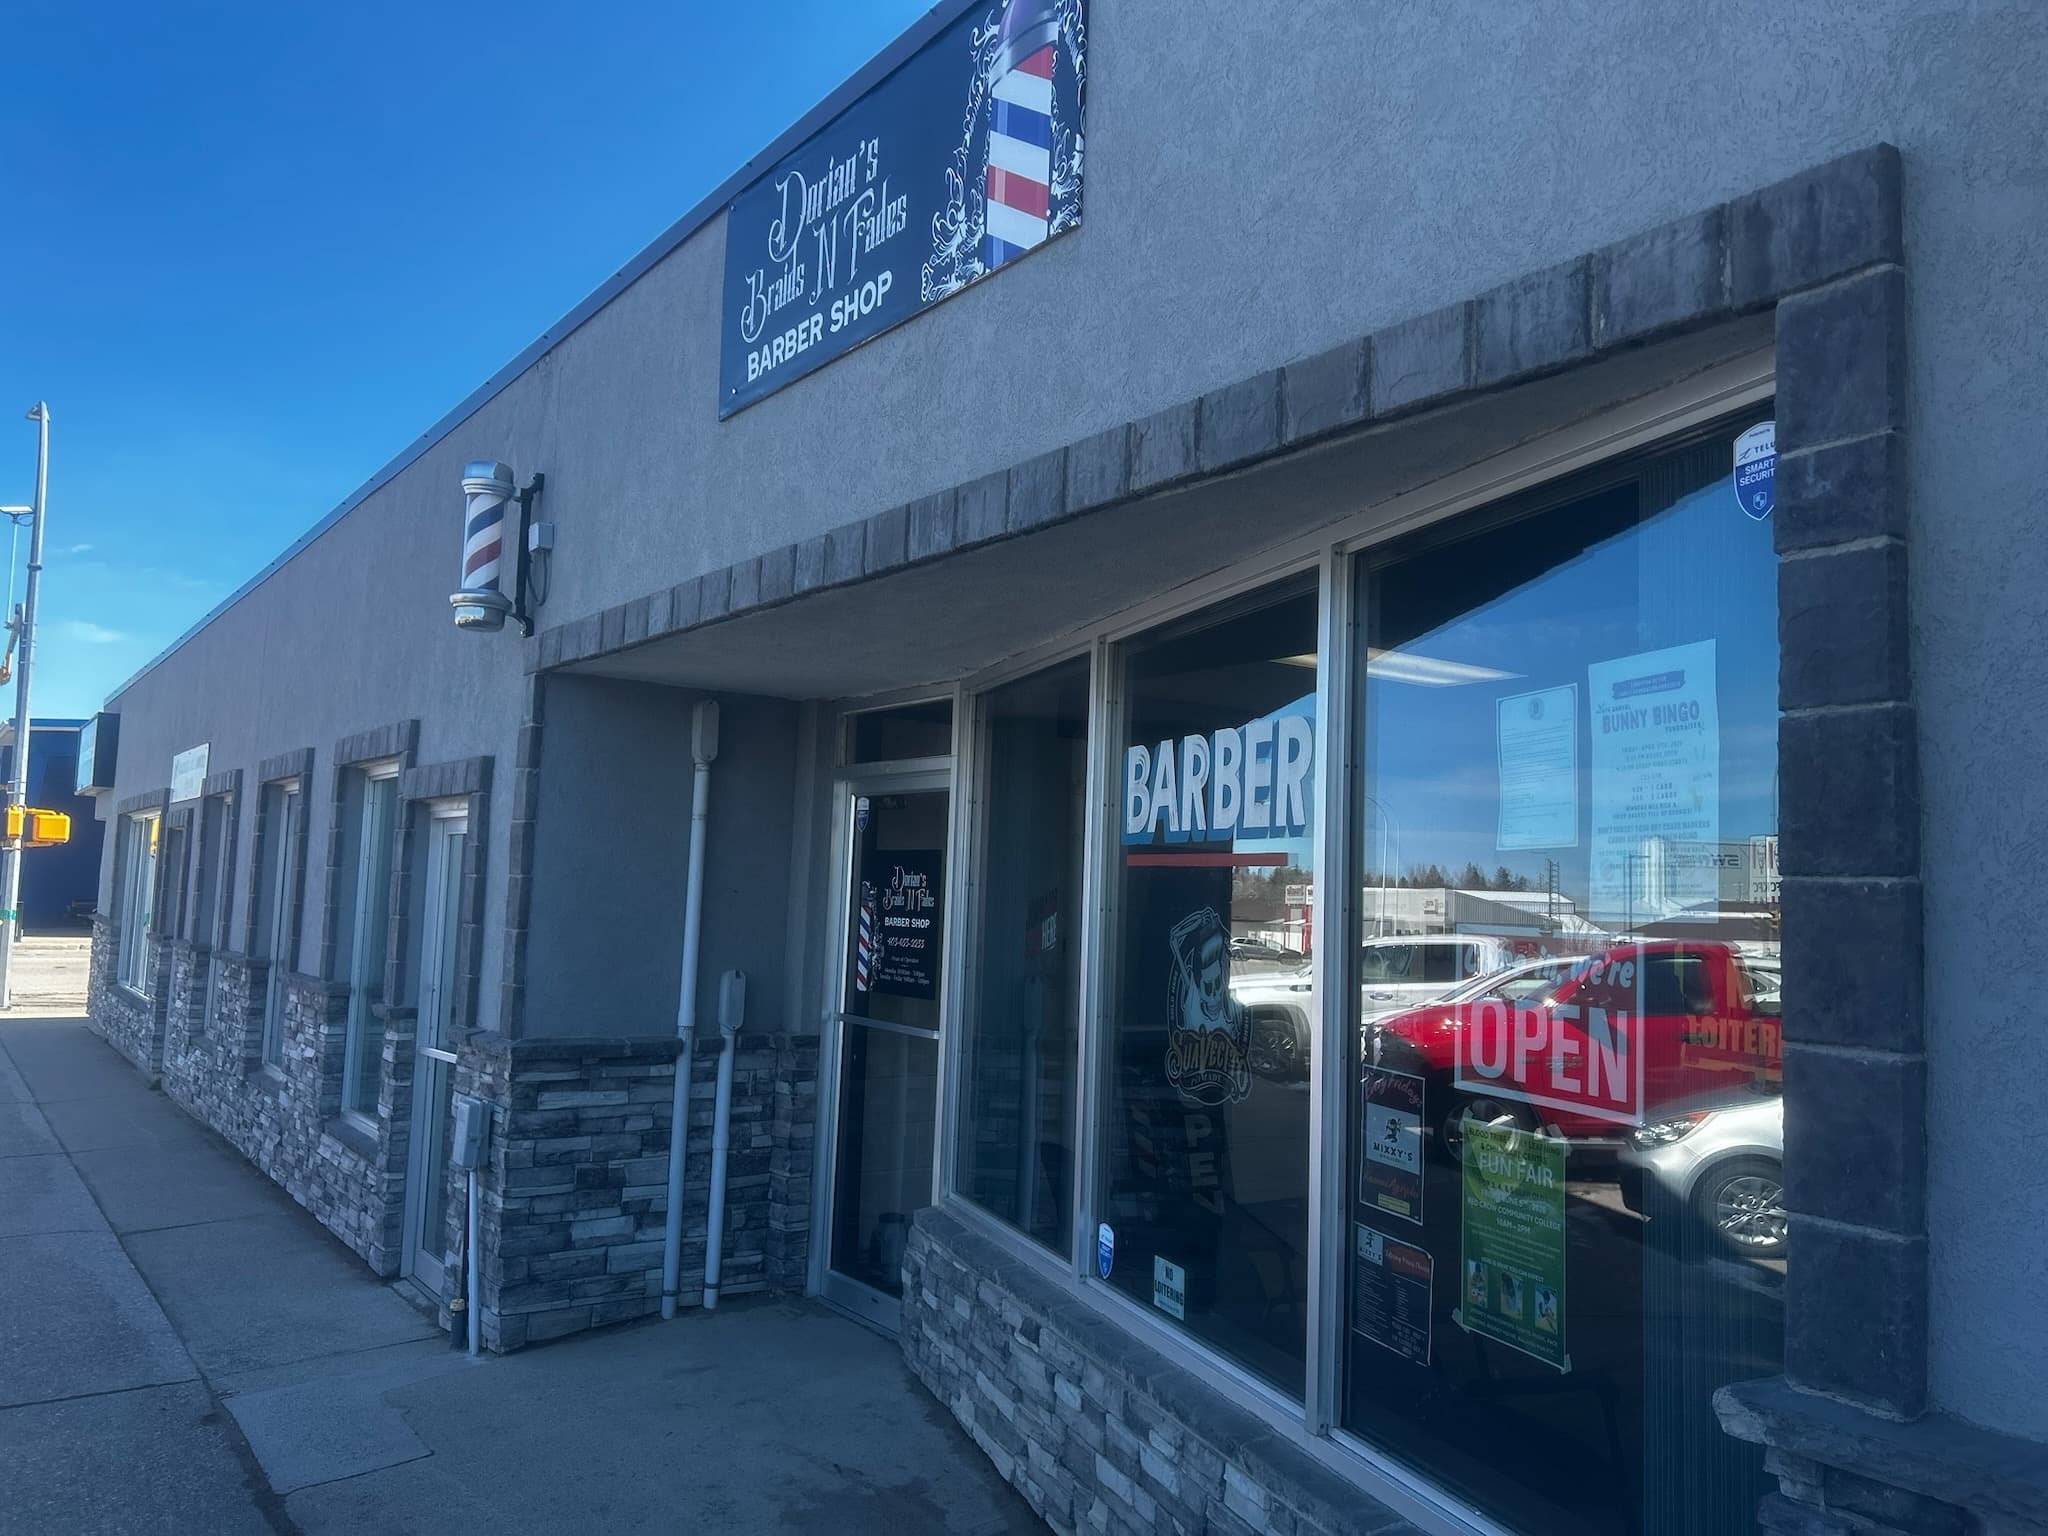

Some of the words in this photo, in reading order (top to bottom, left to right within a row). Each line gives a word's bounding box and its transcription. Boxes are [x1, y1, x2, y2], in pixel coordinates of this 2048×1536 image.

[768, 136, 880, 262] Dorian's
[740, 240, 805, 343] Braids
[809, 215, 838, 306] N
[843, 173, 908, 286] Fades
[747, 312, 823, 383] BARBER
[829, 270, 894, 335] SHOP
[1745, 458, 1775, 475] SMART
[1602, 707, 1648, 735] BUNNY
[1652, 700, 1701, 729] BINGO
[1124, 714, 1314, 840] BARBER
[884, 916, 910, 928] BARBER
[911, 917, 930, 929] SHOP
[1570, 951, 1634, 988] we're
[1471, 997, 1630, 1103] OPEN
[1373, 1142, 1414, 1162] MIXXY'S
[1479, 1151, 1512, 1179] FUN
[1516, 1158, 1554, 1189] FAIR
[1534, 1216, 1562, 1232] COLLEGE
